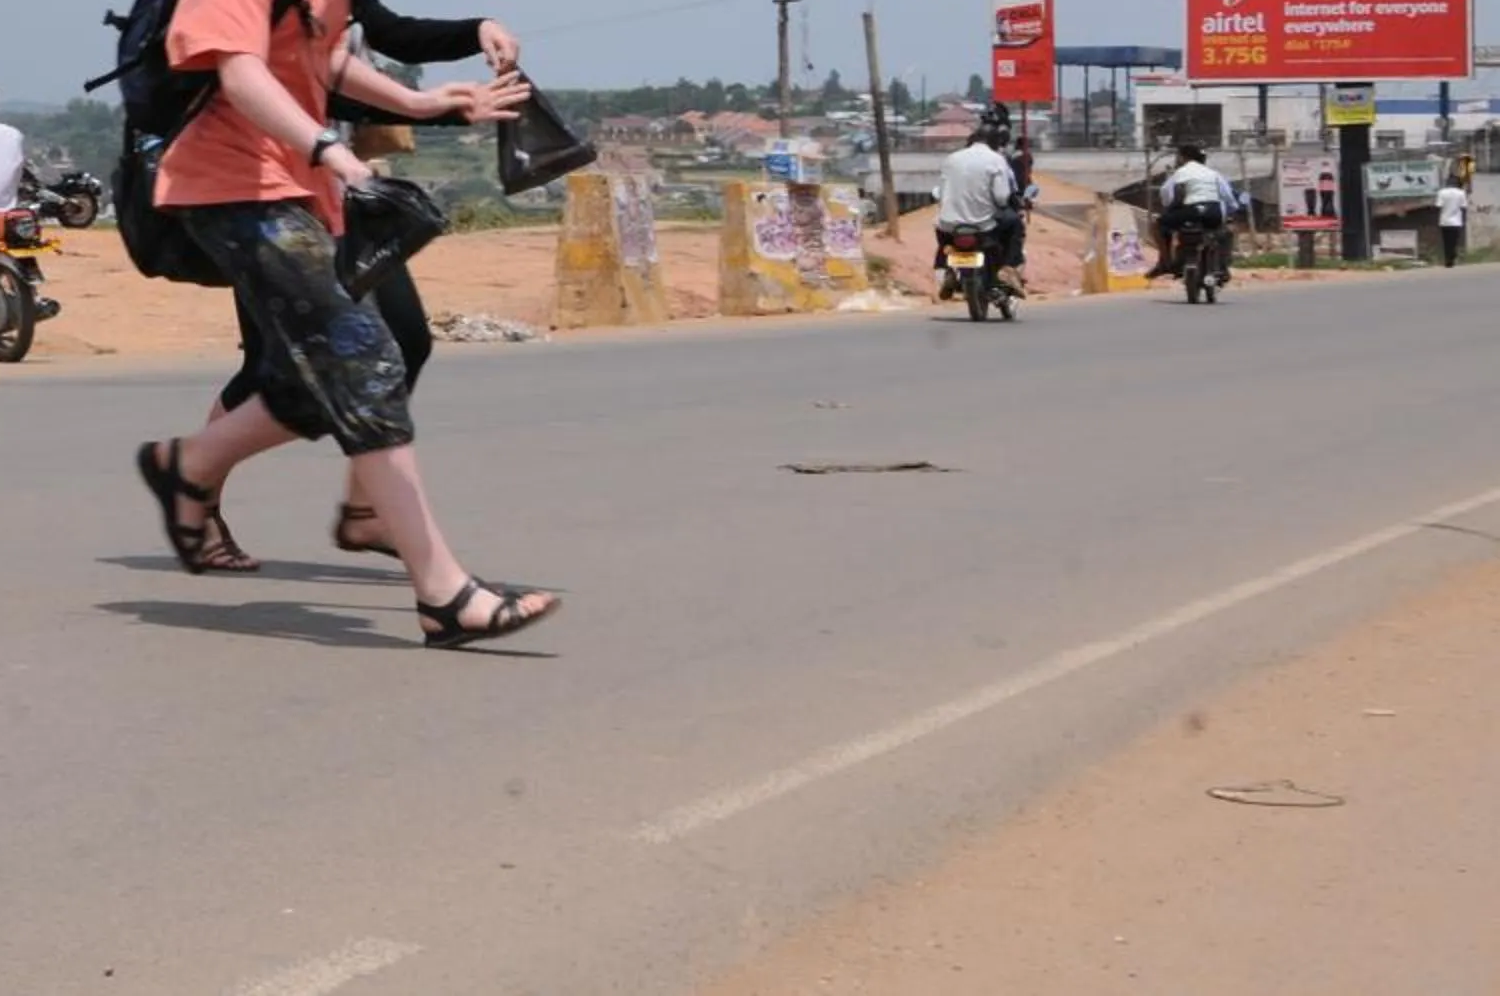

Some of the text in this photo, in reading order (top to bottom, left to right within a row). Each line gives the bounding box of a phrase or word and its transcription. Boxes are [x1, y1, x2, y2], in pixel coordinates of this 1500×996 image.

[1284, 0, 1448, 18] internet for everyone
[1202, 11, 1265, 33] airtel
[1284, 18, 1375, 36] everywhere
[1203, 46, 1268, 65] 3.75G
